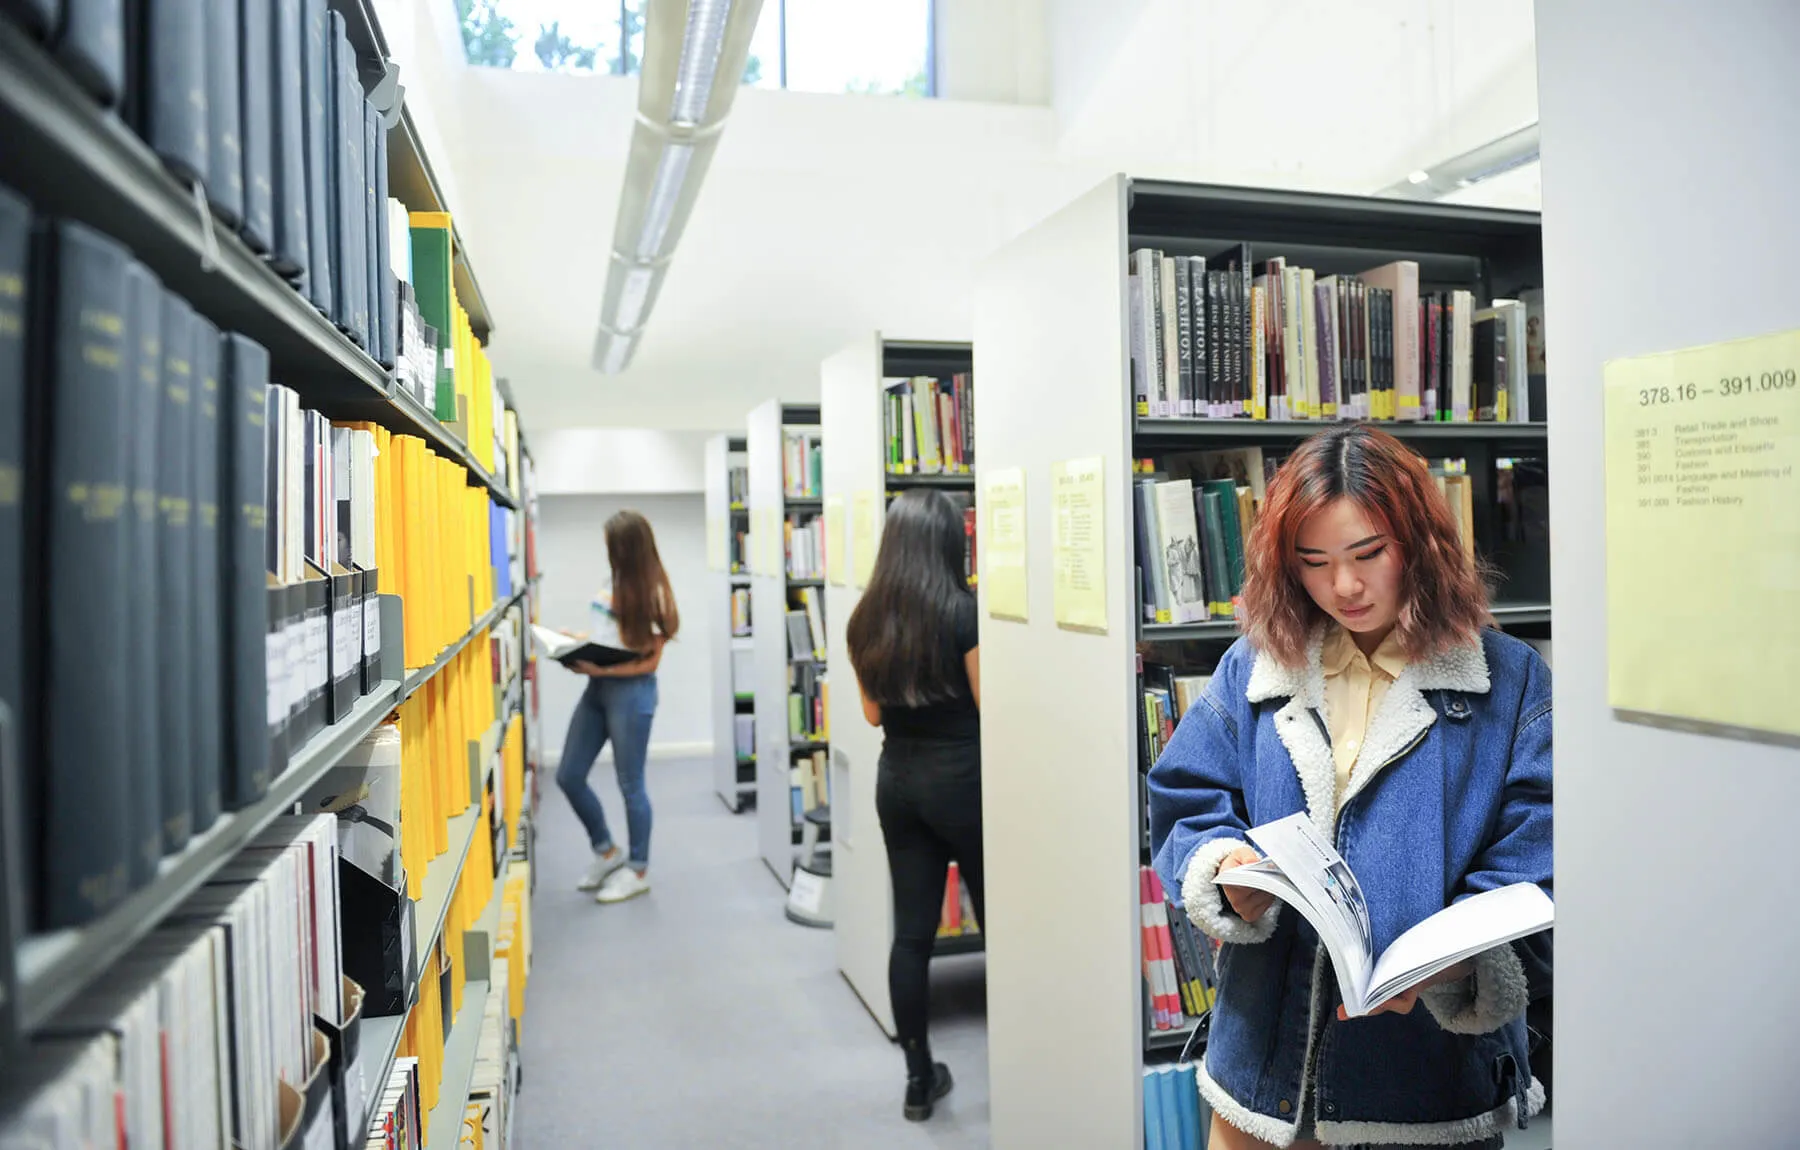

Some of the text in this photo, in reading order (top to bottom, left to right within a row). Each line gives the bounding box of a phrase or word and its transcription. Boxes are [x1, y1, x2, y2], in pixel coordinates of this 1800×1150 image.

[1179, 286, 1191, 361] FASHION
[1194, 286, 1206, 360] FASHION
[1212, 327, 1220, 340] OF
[1223, 327, 1232, 340] OF
[1212, 342, 1221, 383] FASHION
[1223, 342, 1232, 383] FASHION
[1234, 343, 1243, 384] FASHION
[1639, 382, 1698, 407] 378.16
[1719, 368, 1797, 397] 391.009
[1675, 424, 1699, 435] Retail
[1701, 421, 1728, 432] Trade
[1729, 418, 1747, 430] and
[1749, 415, 1779, 429] Shops
[1675, 433, 1738, 447] Transportation
[1675, 447, 1713, 459] Customs
[1715, 445, 1733, 456] and
[1637, 460, 1709, 473] 391 Fashion
[1675, 471, 1719, 485] Language
[1720, 469, 1738, 480] and
[1740, 466, 1780, 480] Meaning
[1782, 464, 1792, 478] of
[1675, 484, 1710, 495] Fashion
[1676, 496, 1711, 507] Fashion
[1711, 495, 1744, 507] History
